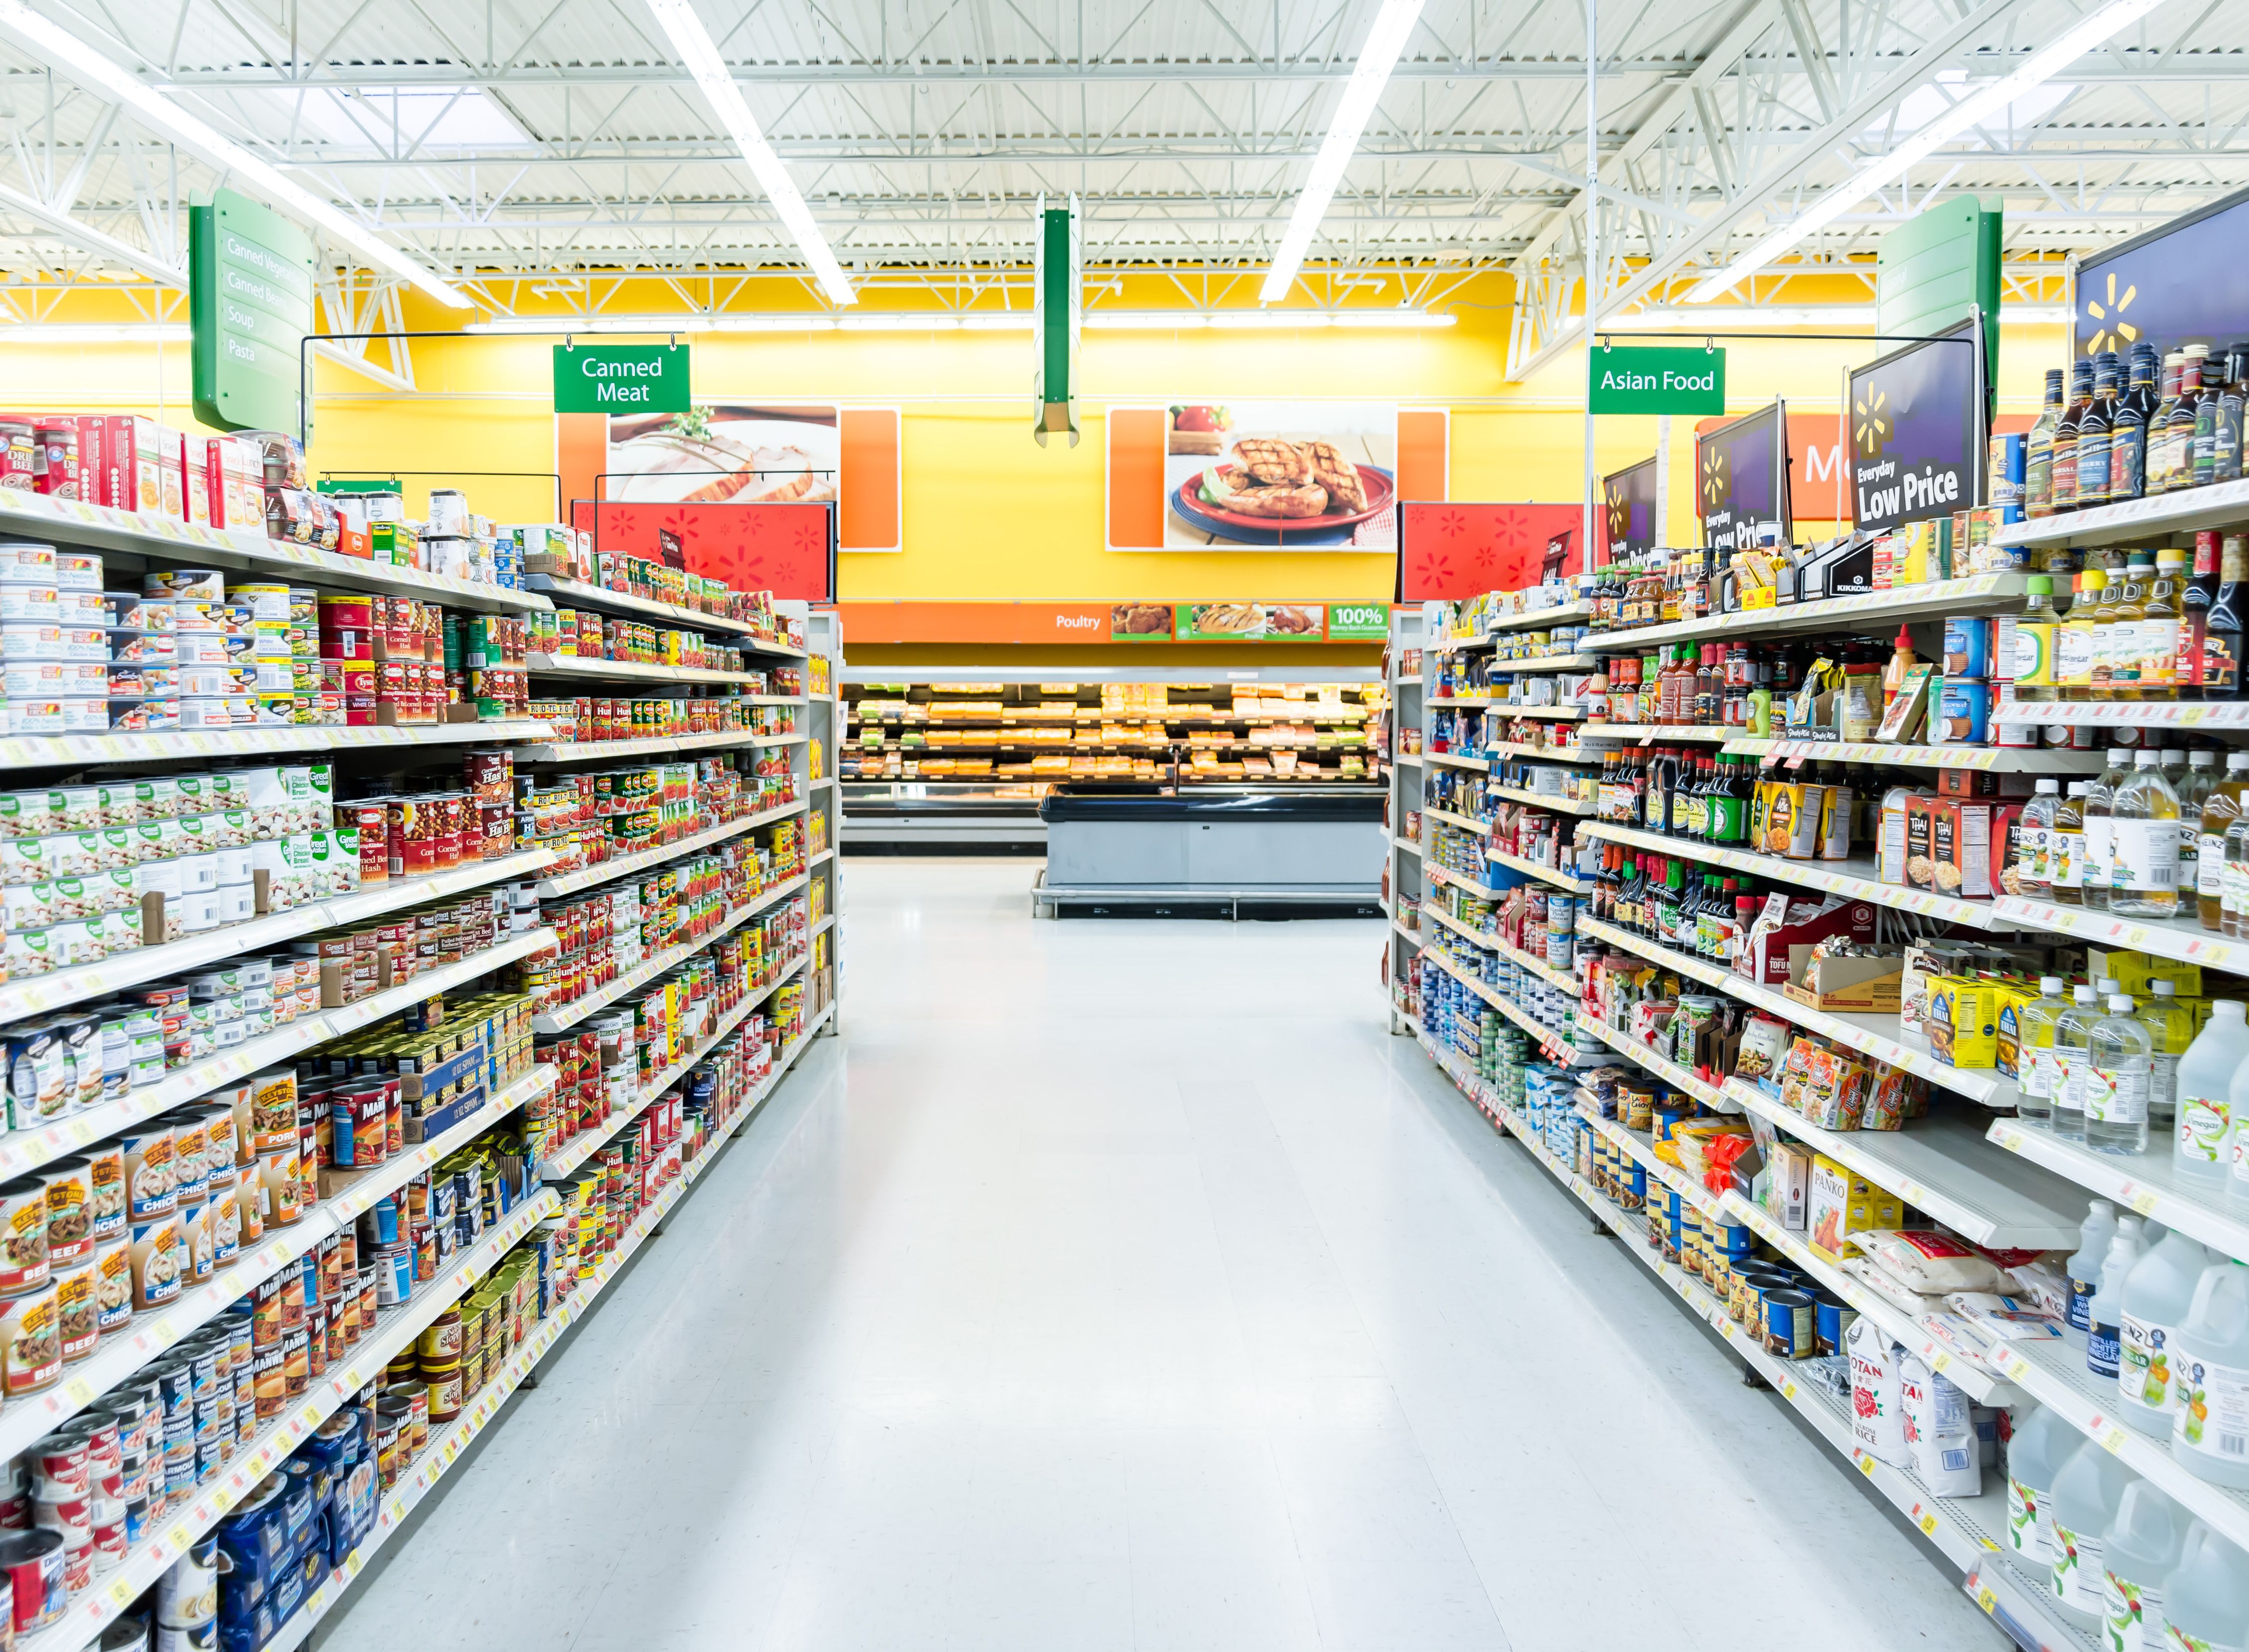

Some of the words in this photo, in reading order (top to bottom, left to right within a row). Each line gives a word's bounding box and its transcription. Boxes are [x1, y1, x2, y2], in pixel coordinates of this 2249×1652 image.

[228, 238, 263, 266] Canned
[228, 272, 264, 299] Canned
[266, 288, 287, 308] Beans
[229, 306, 253, 330] Soup
[229, 339, 255, 361] Pasta
[582, 357, 662, 377] Canned
[1600, 371, 1657, 390] Asian
[1663, 371, 1714, 390] Food
[597, 383, 650, 401] Meat
[1857, 460, 1895, 484] Everyday
[1859, 486, 1900, 522] Low
[1903, 465, 1958, 511] Price
[1706, 510, 1730, 528] Everyday
[1736, 516, 1759, 550] Pric
[1611, 540, 1627, 553] Everyday
[1056, 615, 1101, 631] Poultry
[1336, 608, 1383, 625] 100%
[311, 772, 329, 780] Great
[1910, 817, 1927, 831] THAI
[1936, 822, 1951, 836] THAI
[1769, 961, 1786, 969] TOFU
[506, 1007, 518, 1019] SPAM
[519, 999, 533, 1012] SPAM
[492, 1014, 504, 1029] SPAM
[1933, 1008, 1948, 1023] THAI
[2000, 1020, 2017, 1036] THAI
[462, 1030, 476, 1044] SPAM
[520, 1035, 533, 1048] SPAM
[443, 1040, 456, 1055] SPAM
[507, 1044, 520, 1057] SPAM
[422, 1050, 436, 1066] SPAM
[462, 1055, 475, 1070] SPAM
[495, 1053, 507, 1067] SPAM
[478, 1062, 490, 1077] SPAM
[462, 1071, 476, 1088] SPAM
[442, 1083, 456, 1099] SPAM
[421, 1093, 436, 1110] SPAM
[464, 1097, 478, 1113] SPAM
[2186, 1115, 2220, 1131] Vinegar
[269, 1130, 296, 1144] PORK
[1814, 1172, 1845, 1199] PANKO
[489, 1301, 501, 1319] SPAM
[2072, 1305, 2090, 1317] VINE
[468, 1318, 482, 1335] SPAM
[64, 1333, 97, 1353] BEEF
[488, 1340, 501, 1358] SPAM
[2091, 1341, 2116, 1354] WHITE
[468, 1357, 482, 1376] SPAM
[1902, 1383, 1922, 1401] TAN
[1855, 1427, 1878, 1445] RICE
